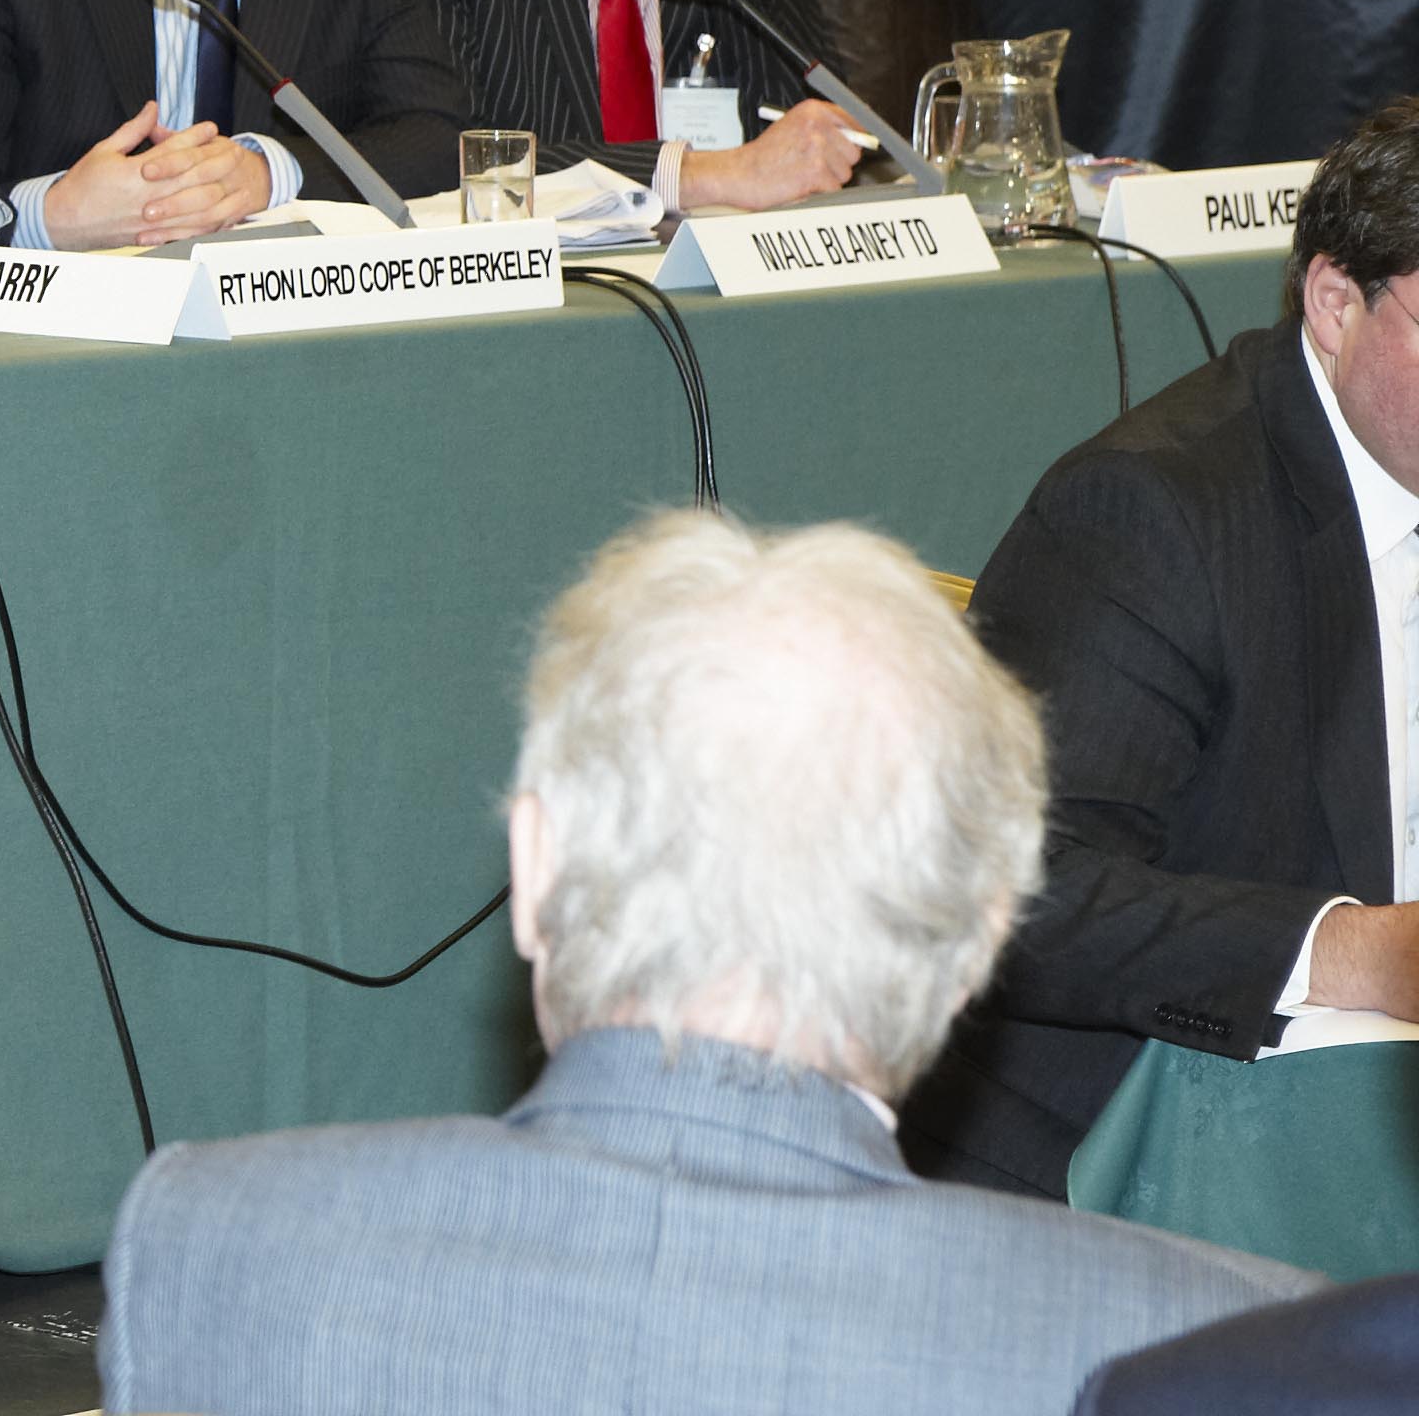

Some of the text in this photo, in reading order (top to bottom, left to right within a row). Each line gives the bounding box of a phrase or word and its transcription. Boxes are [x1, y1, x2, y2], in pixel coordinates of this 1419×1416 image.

[1205, 187, 1301, 232] PAUL KE
[751, 218, 938, 272] NIALL BLANEY TD
[219, 247, 553, 306] RT HON LORD COPE OF BERKELEY
